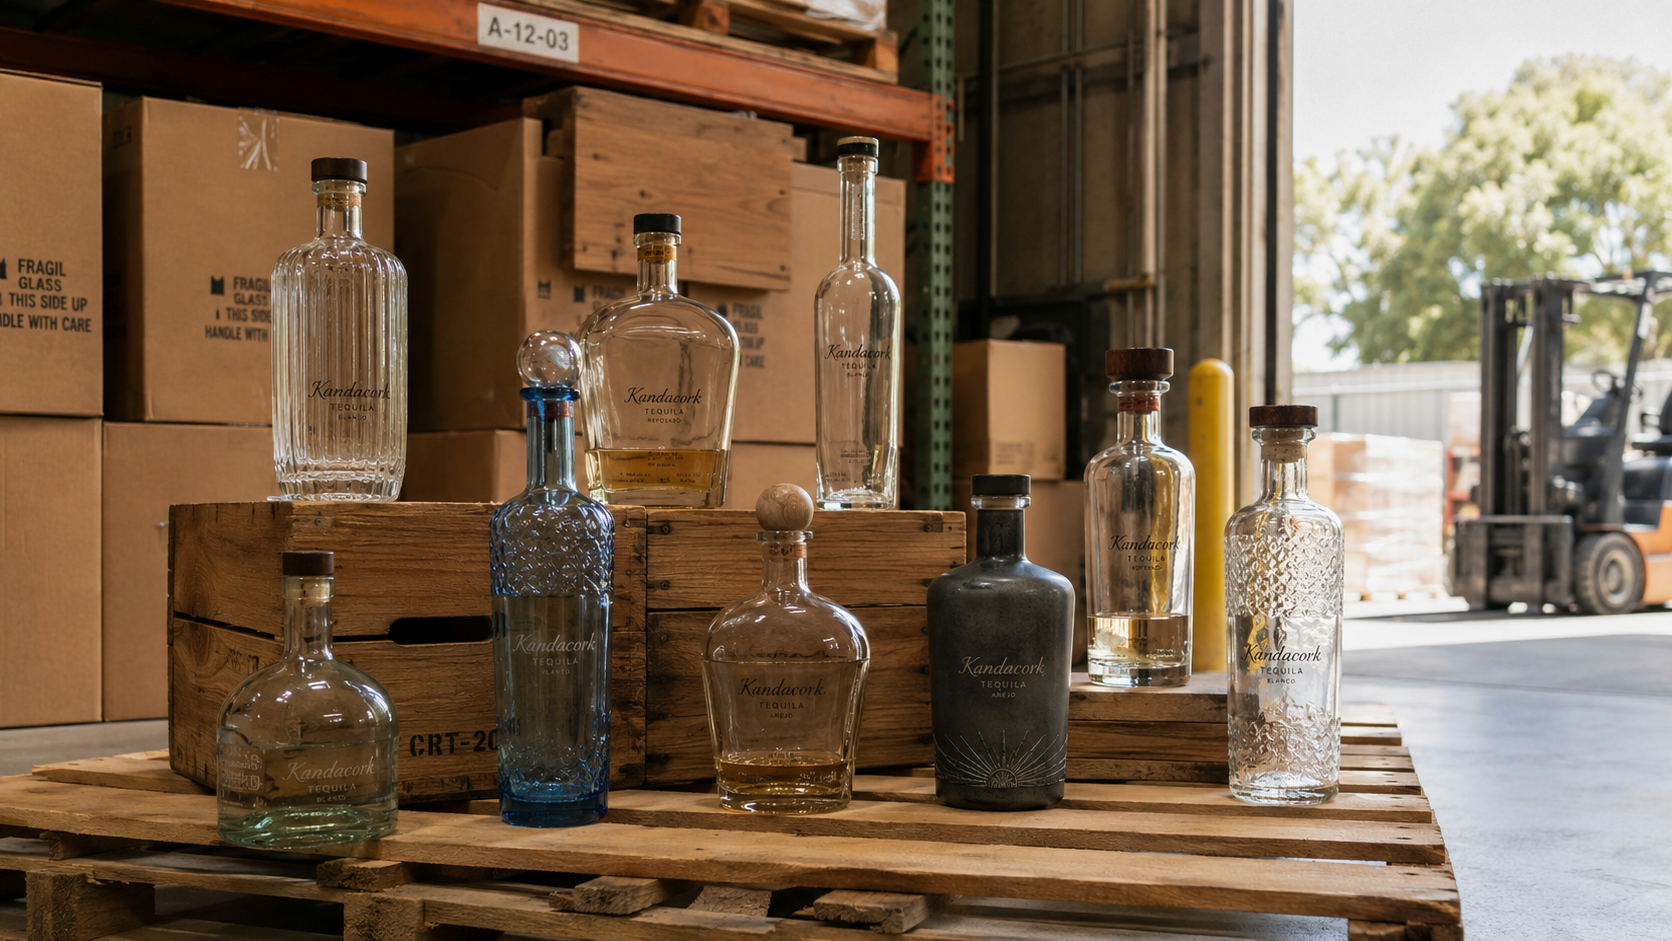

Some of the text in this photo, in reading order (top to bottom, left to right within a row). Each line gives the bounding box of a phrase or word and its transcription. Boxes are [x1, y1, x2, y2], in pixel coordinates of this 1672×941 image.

[488, 16, 568, 52] A-12-03
[18, 258, 67, 277] FRAGIL
[18, 276, 63, 292] GLASS
[8, 292, 88, 312] THIS SIDE UP
[234, 292, 268, 307] GLASS
[0, 313, 92, 333] DLE WITH CARE
[226, 307, 249, 322] THIS
[205, 325, 242, 341] HANDLE
[824, 343, 891, 361] Kandacork
[308, 379, 391, 401] Kandacork
[624, 386, 702, 406] Kandacork
[330, 402, 374, 412] TEQUILA
[645, 407, 684, 416] TEQUILA
[1108, 534, 1183, 552] Kandacork
[512, 632, 596, 655] Kandacork
[532, 657, 579, 667] TEQUILA
[1241, 644, 1321, 664] Kandacork
[958, 656, 1046, 678] Kandacork
[1260, 666, 1303, 676] TEQUILA
[737, 678, 826, 698] Kandacork
[980, 680, 1026, 690] TEQUILA
[759, 701, 804, 710] TEQUILA
[282, 755, 375, 783] Kandacork
[308, 783, 357, 794] TEQUILA
